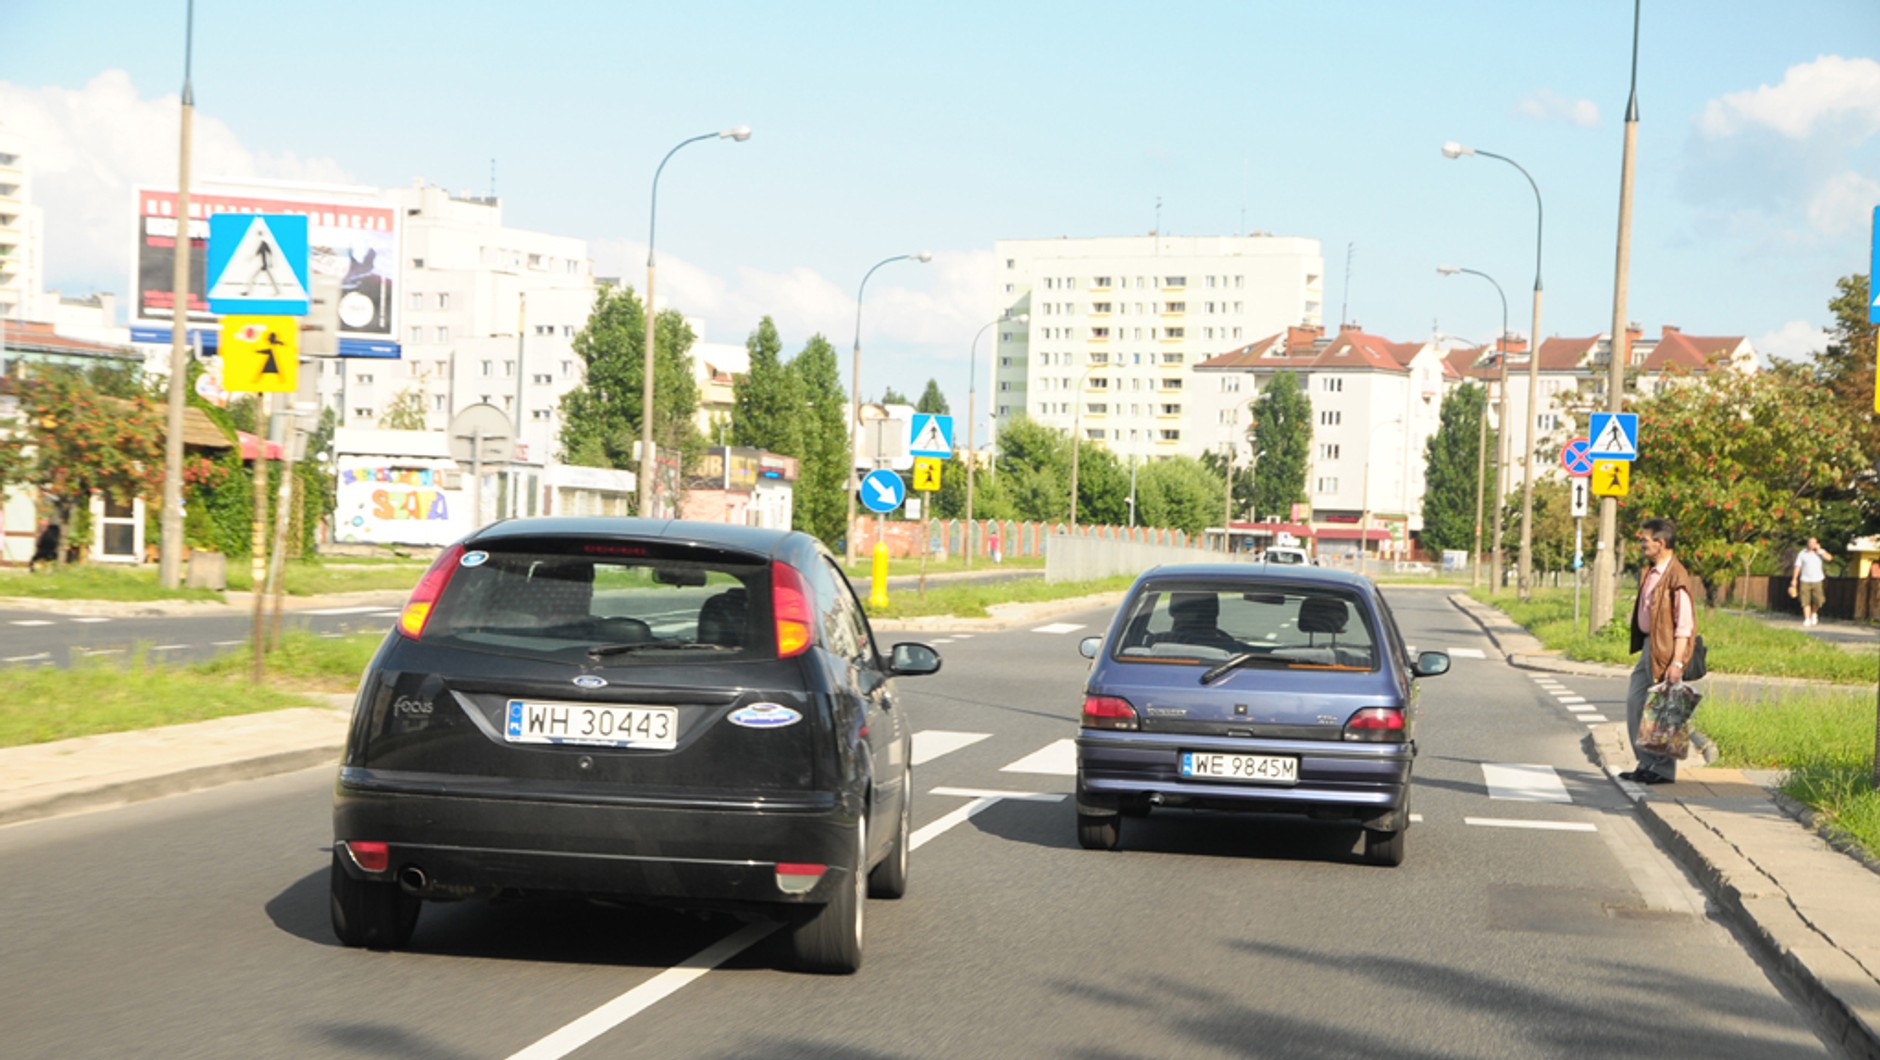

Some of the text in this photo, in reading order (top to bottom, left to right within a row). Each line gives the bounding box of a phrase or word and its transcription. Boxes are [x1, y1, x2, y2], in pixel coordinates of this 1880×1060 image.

[529, 706, 669, 739] WH 30443
[1196, 755, 1223, 775] WE
[1232, 757, 1294, 778] 9845M
